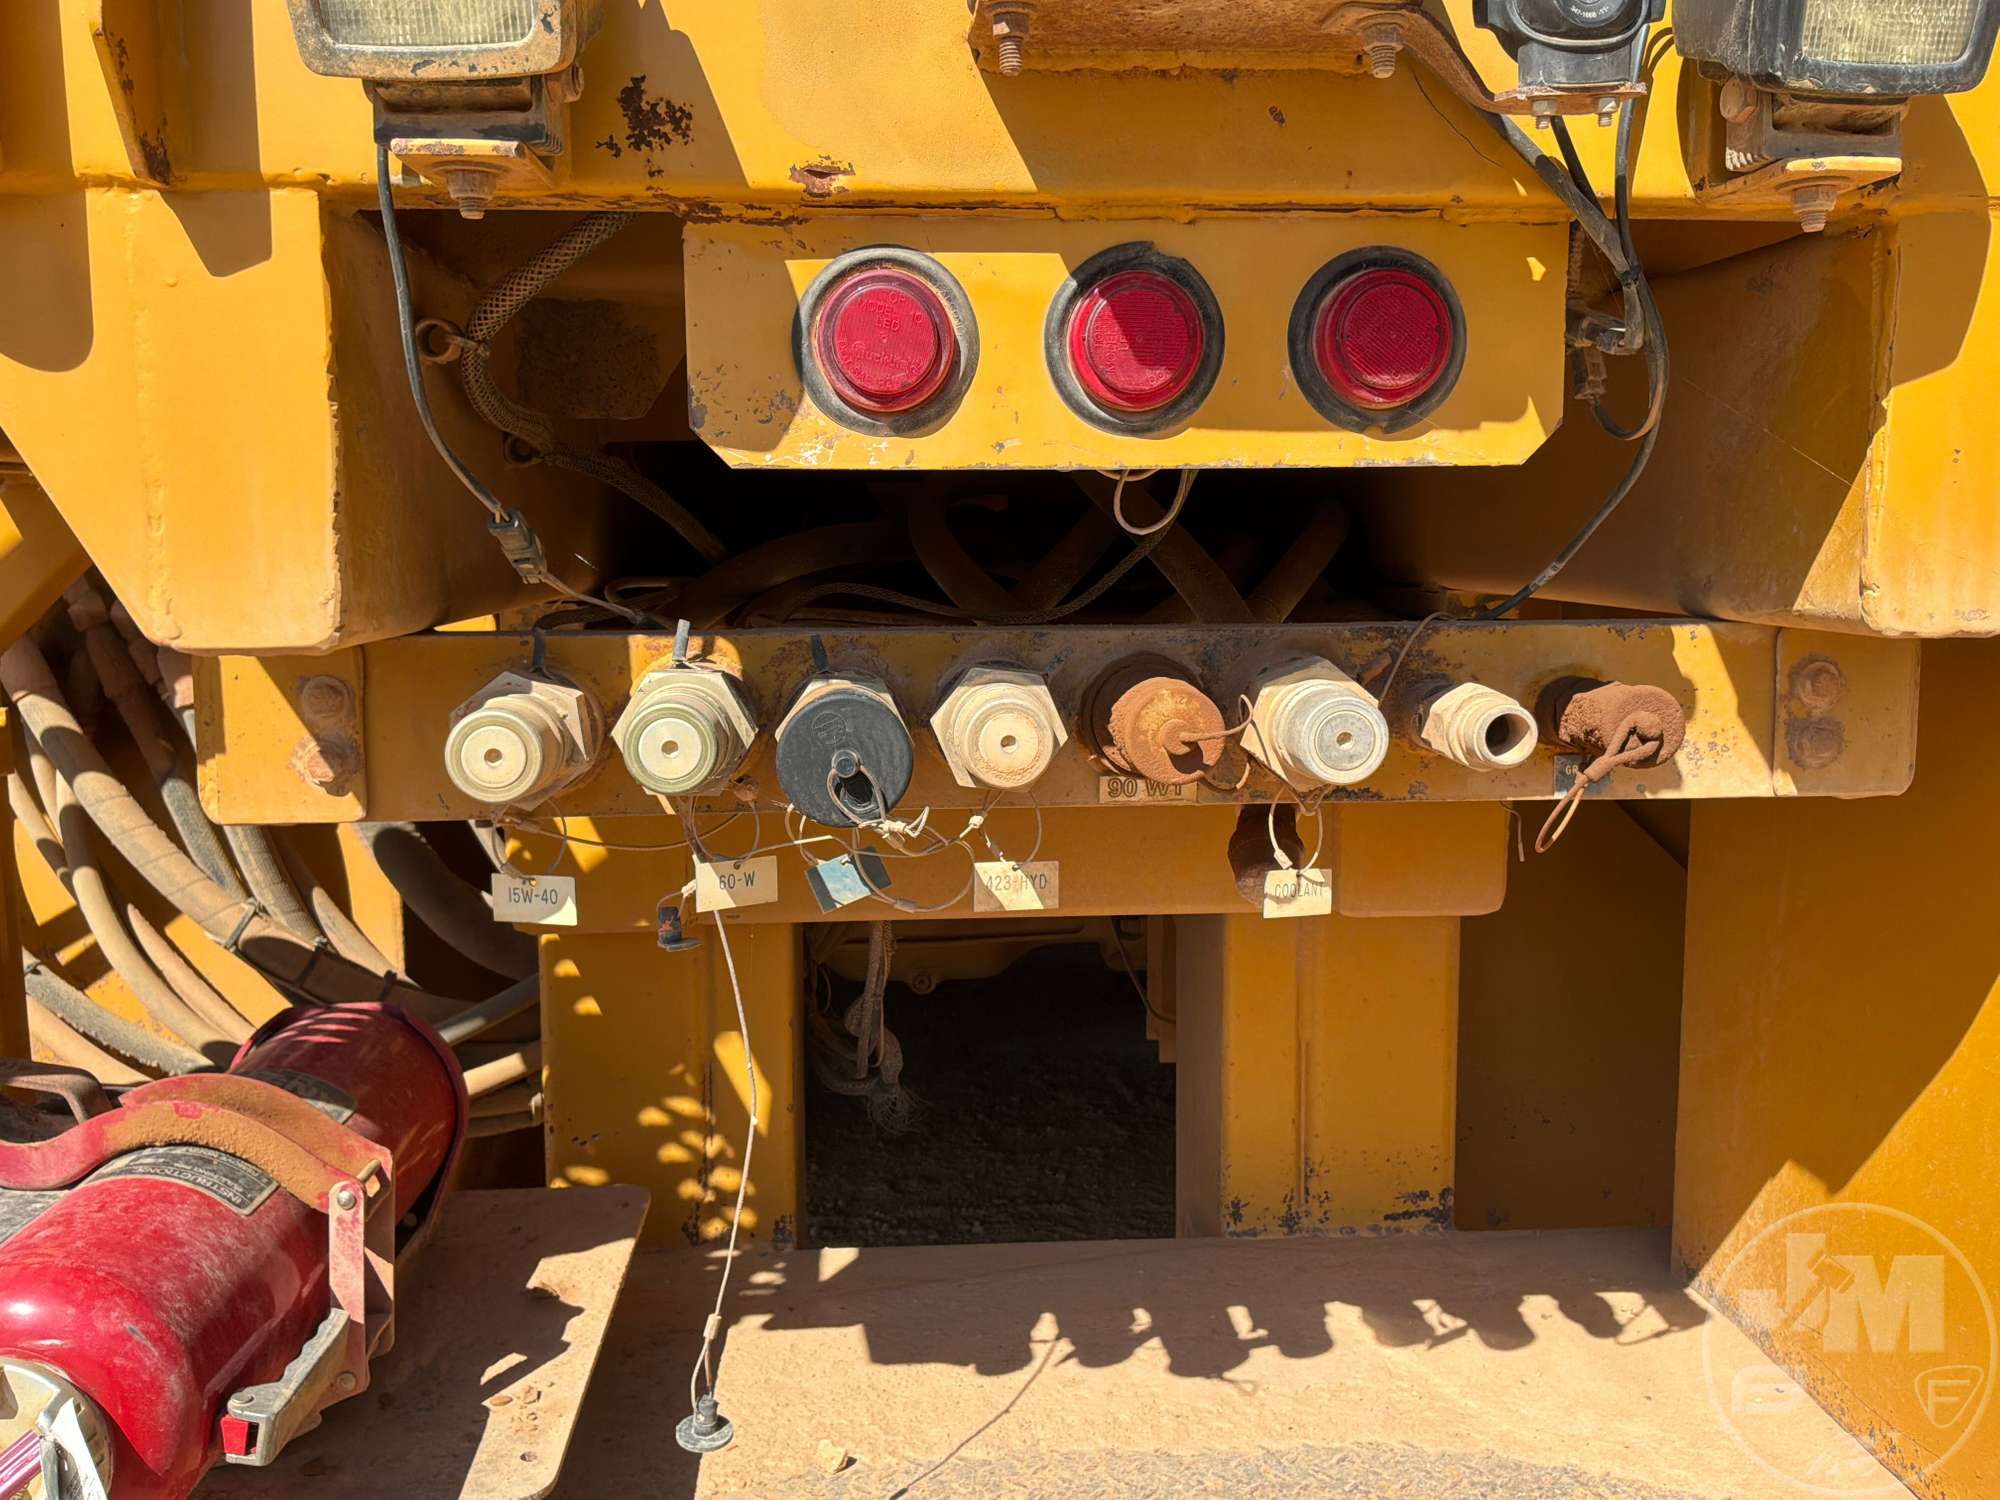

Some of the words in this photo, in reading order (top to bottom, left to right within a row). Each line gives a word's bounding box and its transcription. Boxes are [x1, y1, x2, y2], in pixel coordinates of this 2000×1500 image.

[1107, 777, 1137, 798] 90
[719, 870, 755, 890] 60-W
[508, 886, 558, 905] 15W-40
